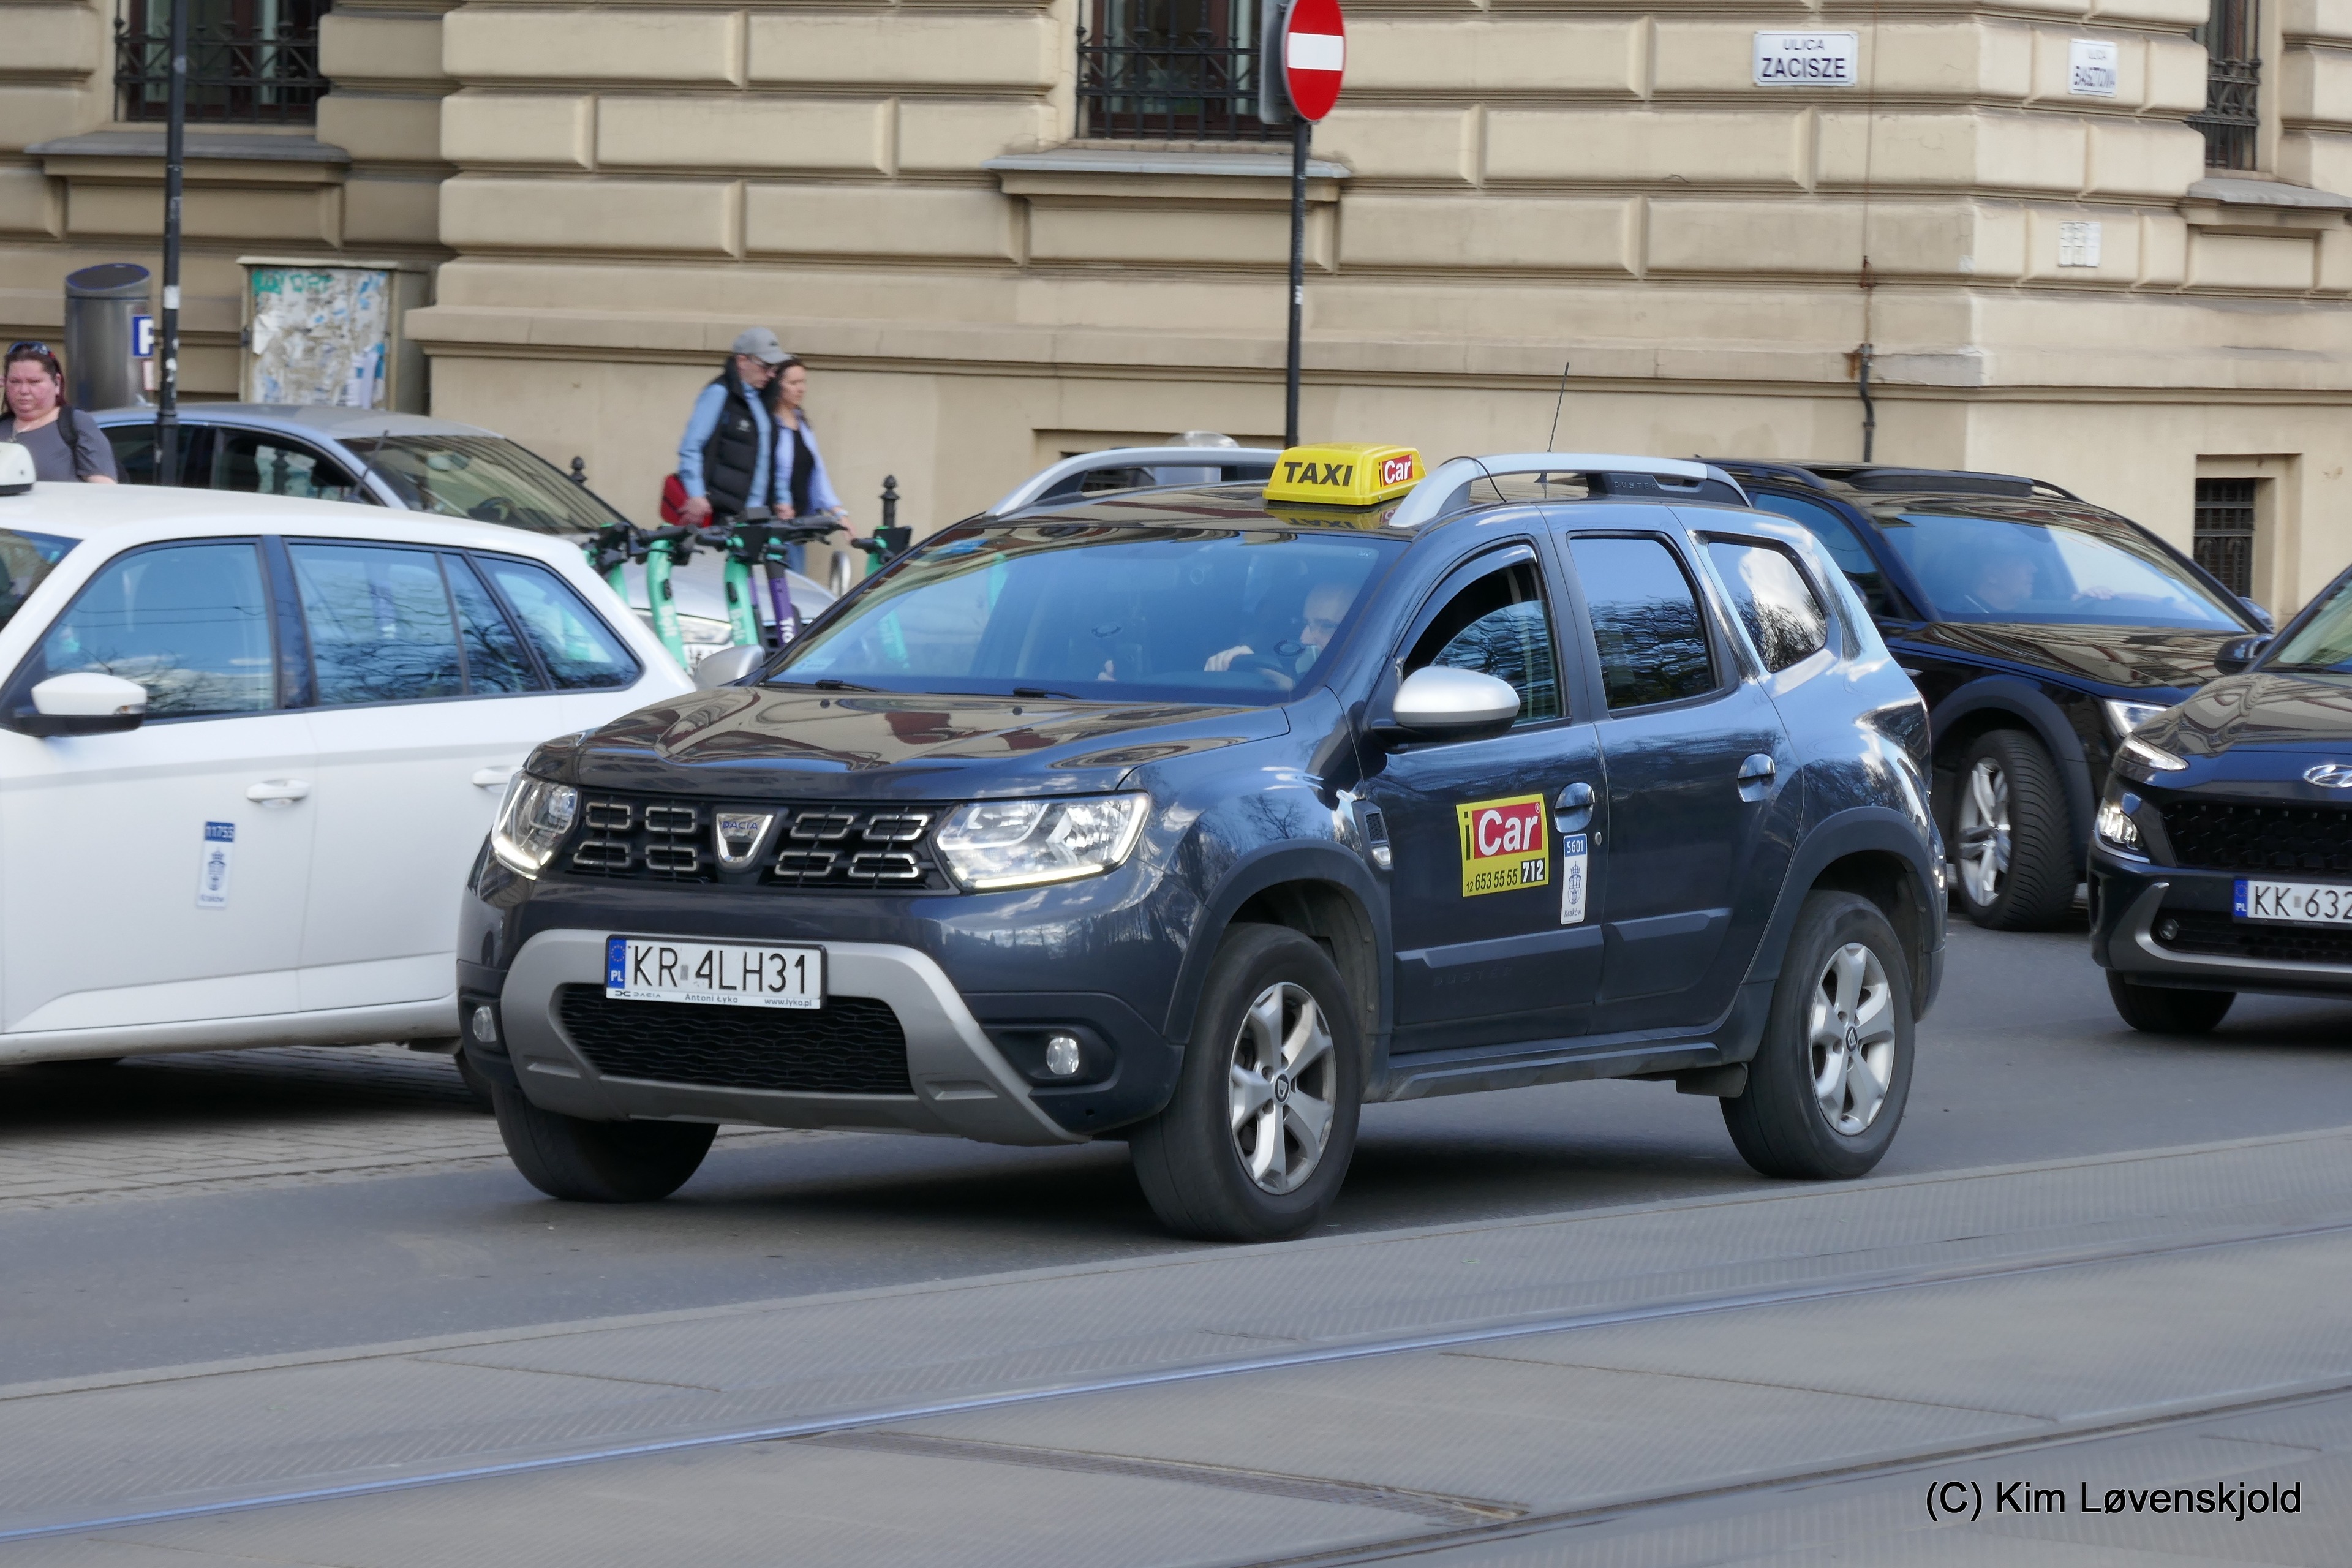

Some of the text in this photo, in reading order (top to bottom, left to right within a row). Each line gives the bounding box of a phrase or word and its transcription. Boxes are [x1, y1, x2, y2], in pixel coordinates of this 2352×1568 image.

[1783, 39, 1825, 50] ULICA
[1762, 57, 1846, 78] ZACISZE
[1284, 461, 1354, 487] TAXI
[1378, 459, 1411, 488] iCar
[722, 821, 758, 830] DACIA
[1464, 809, 1539, 861] iCar
[1566, 840, 1584, 854] 5601
[1466, 859, 1544, 893] 12 653 55 55 712
[2236, 902, 2247, 912] PL
[2255, 885, 2291, 916] KK
[1564, 908, 1582, 918] Kraków
[611, 970, 624, 982] PL
[633, 945, 805, 995] KR 4LH31
[685, 993, 739, 1005] Antoni Łyko
[764, 998, 812, 1007] www.lyko.pl
